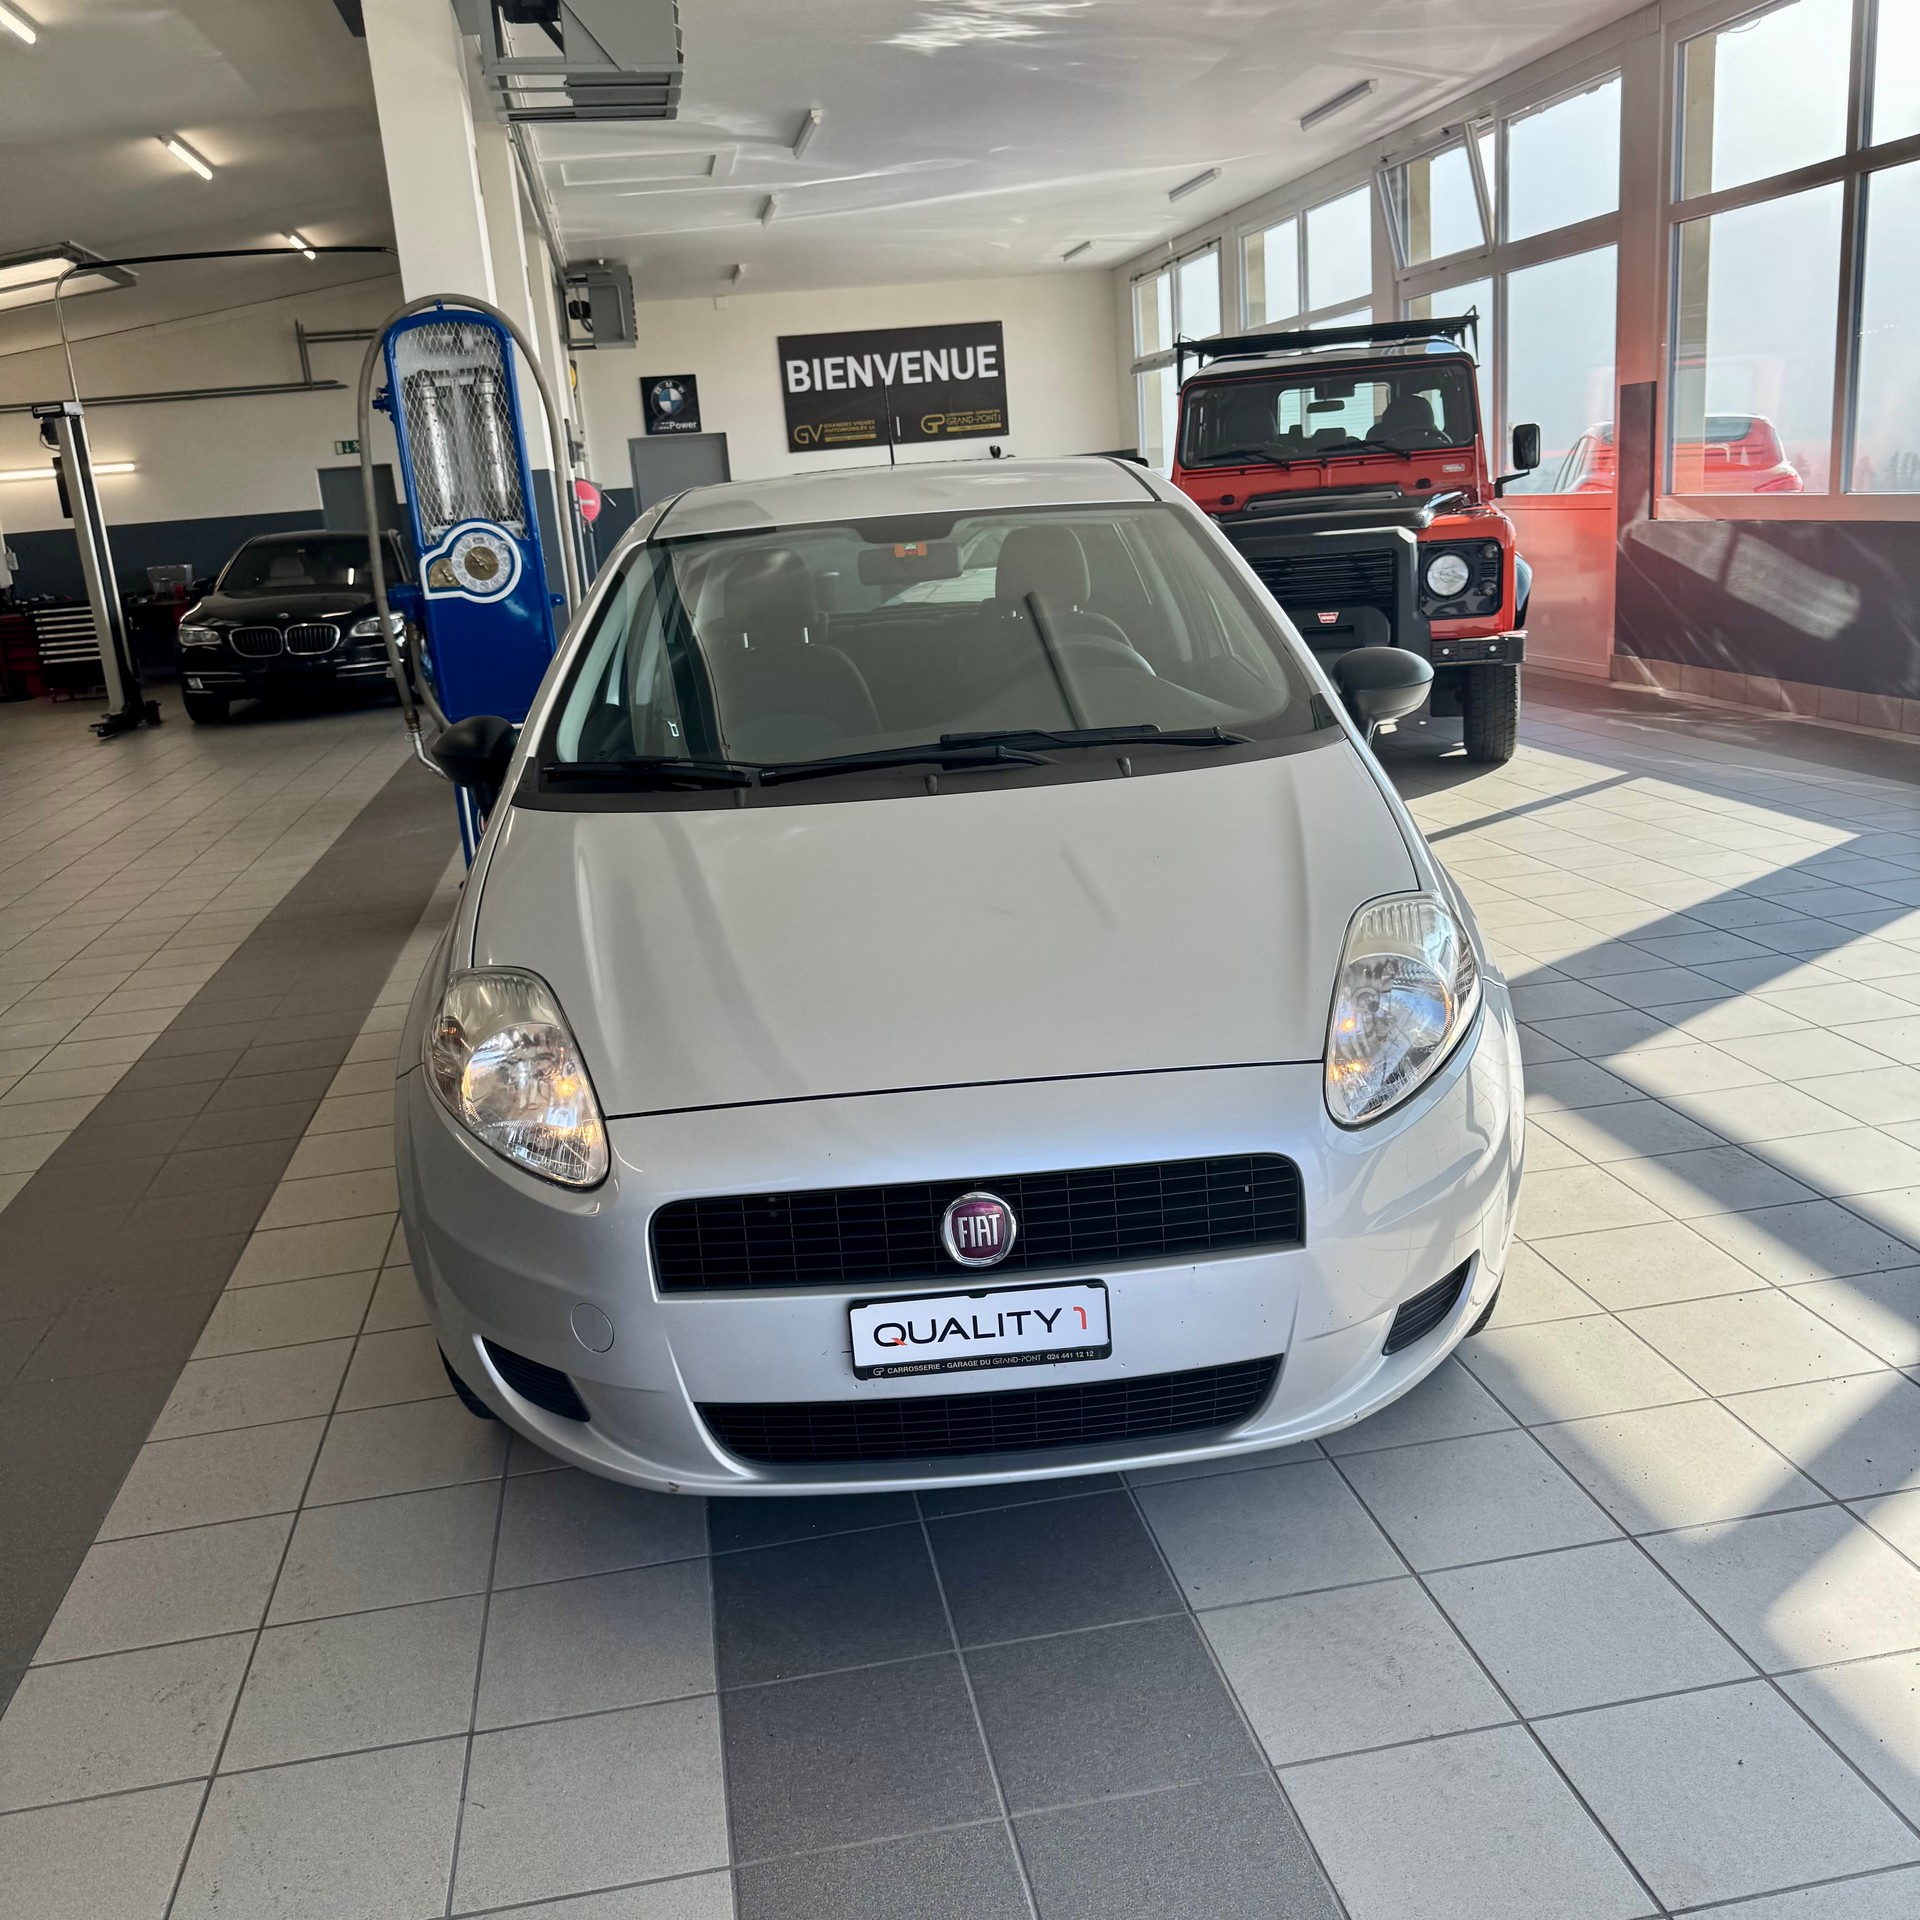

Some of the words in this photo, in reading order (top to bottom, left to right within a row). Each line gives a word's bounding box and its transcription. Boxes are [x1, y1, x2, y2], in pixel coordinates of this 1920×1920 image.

[786, 345, 999, 393] BIENVENUE
[653, 381, 686, 395] BMW
[670, 421, 697, 430] Power
[794, 424, 823, 444] GV
[957, 1214, 1000, 1249] FIAT
[873, 1308, 1062, 1347] QUALITY
[887, 1363, 941, 1374] CARROSSERIE
[947, 1360, 978, 1369] GARAGE
[992, 1354, 1041, 1365] GRAND-PONT
